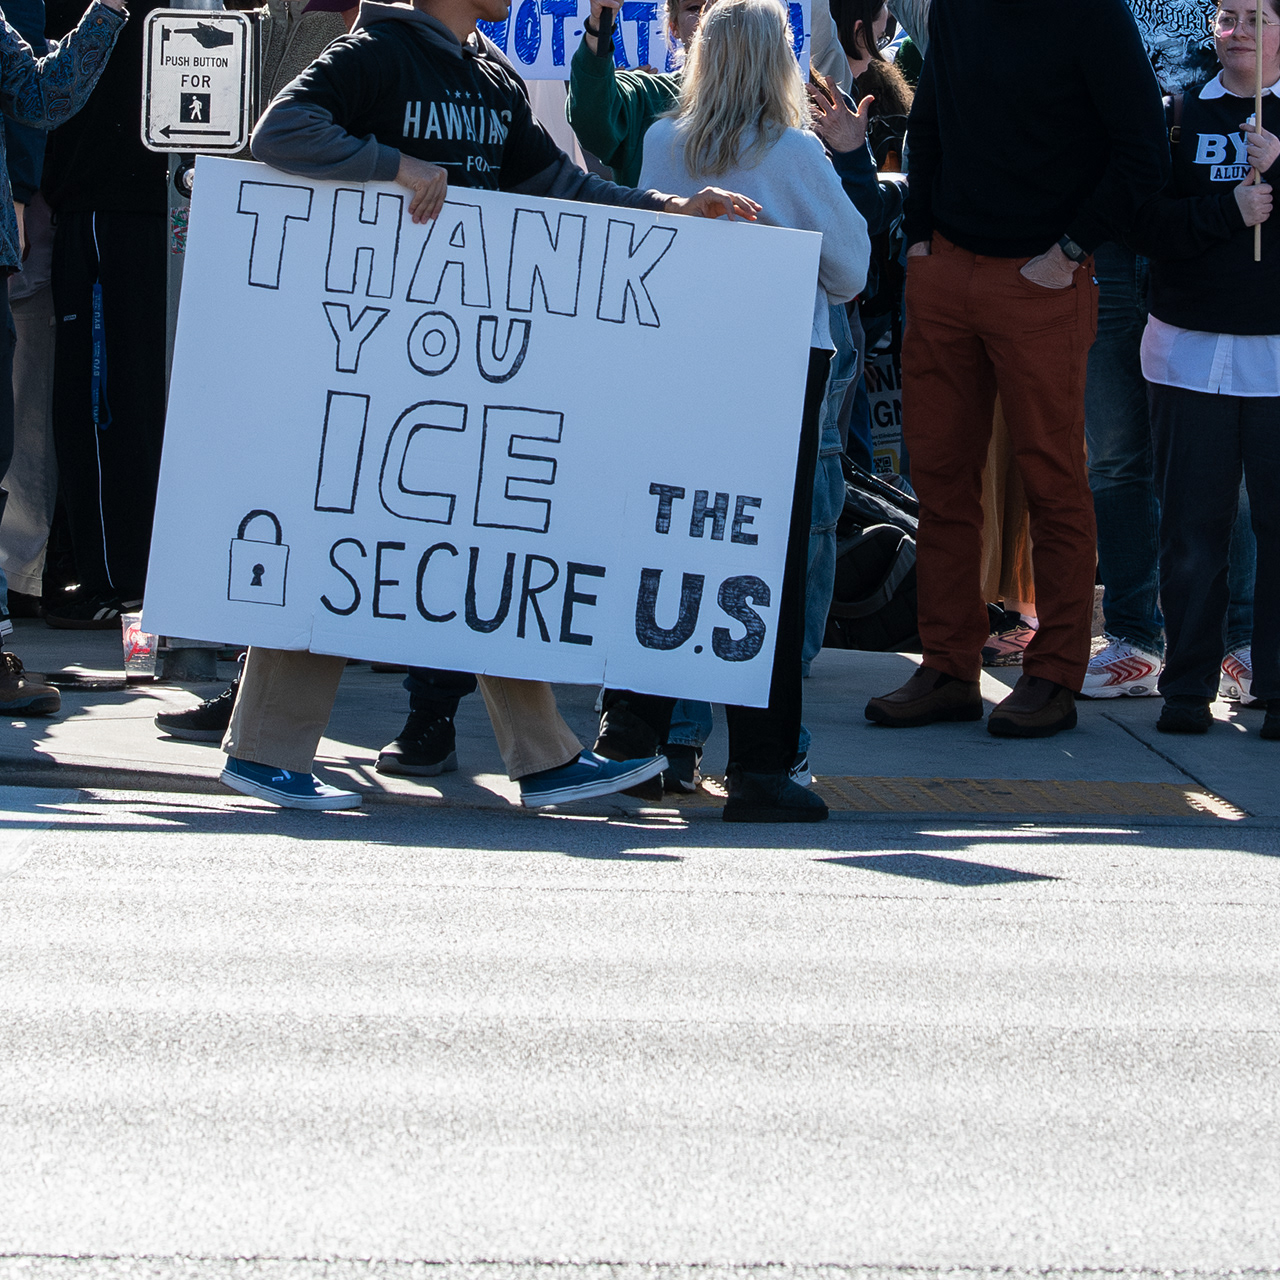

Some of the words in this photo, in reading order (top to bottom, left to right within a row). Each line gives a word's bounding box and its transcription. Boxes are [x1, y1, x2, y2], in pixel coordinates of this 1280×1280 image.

[165, 56, 190, 67] PUSH
[193, 56, 229, 68] BUTTON
[181, 74, 211, 89] FOR
[236, 180, 678, 328] THANK
[322, 300, 531, 384] YOU
[314, 389, 565, 535] ICE
[649, 482, 762, 546] THE
[319, 537, 606, 646] SECURE
[634, 567, 772, 662] U.S
